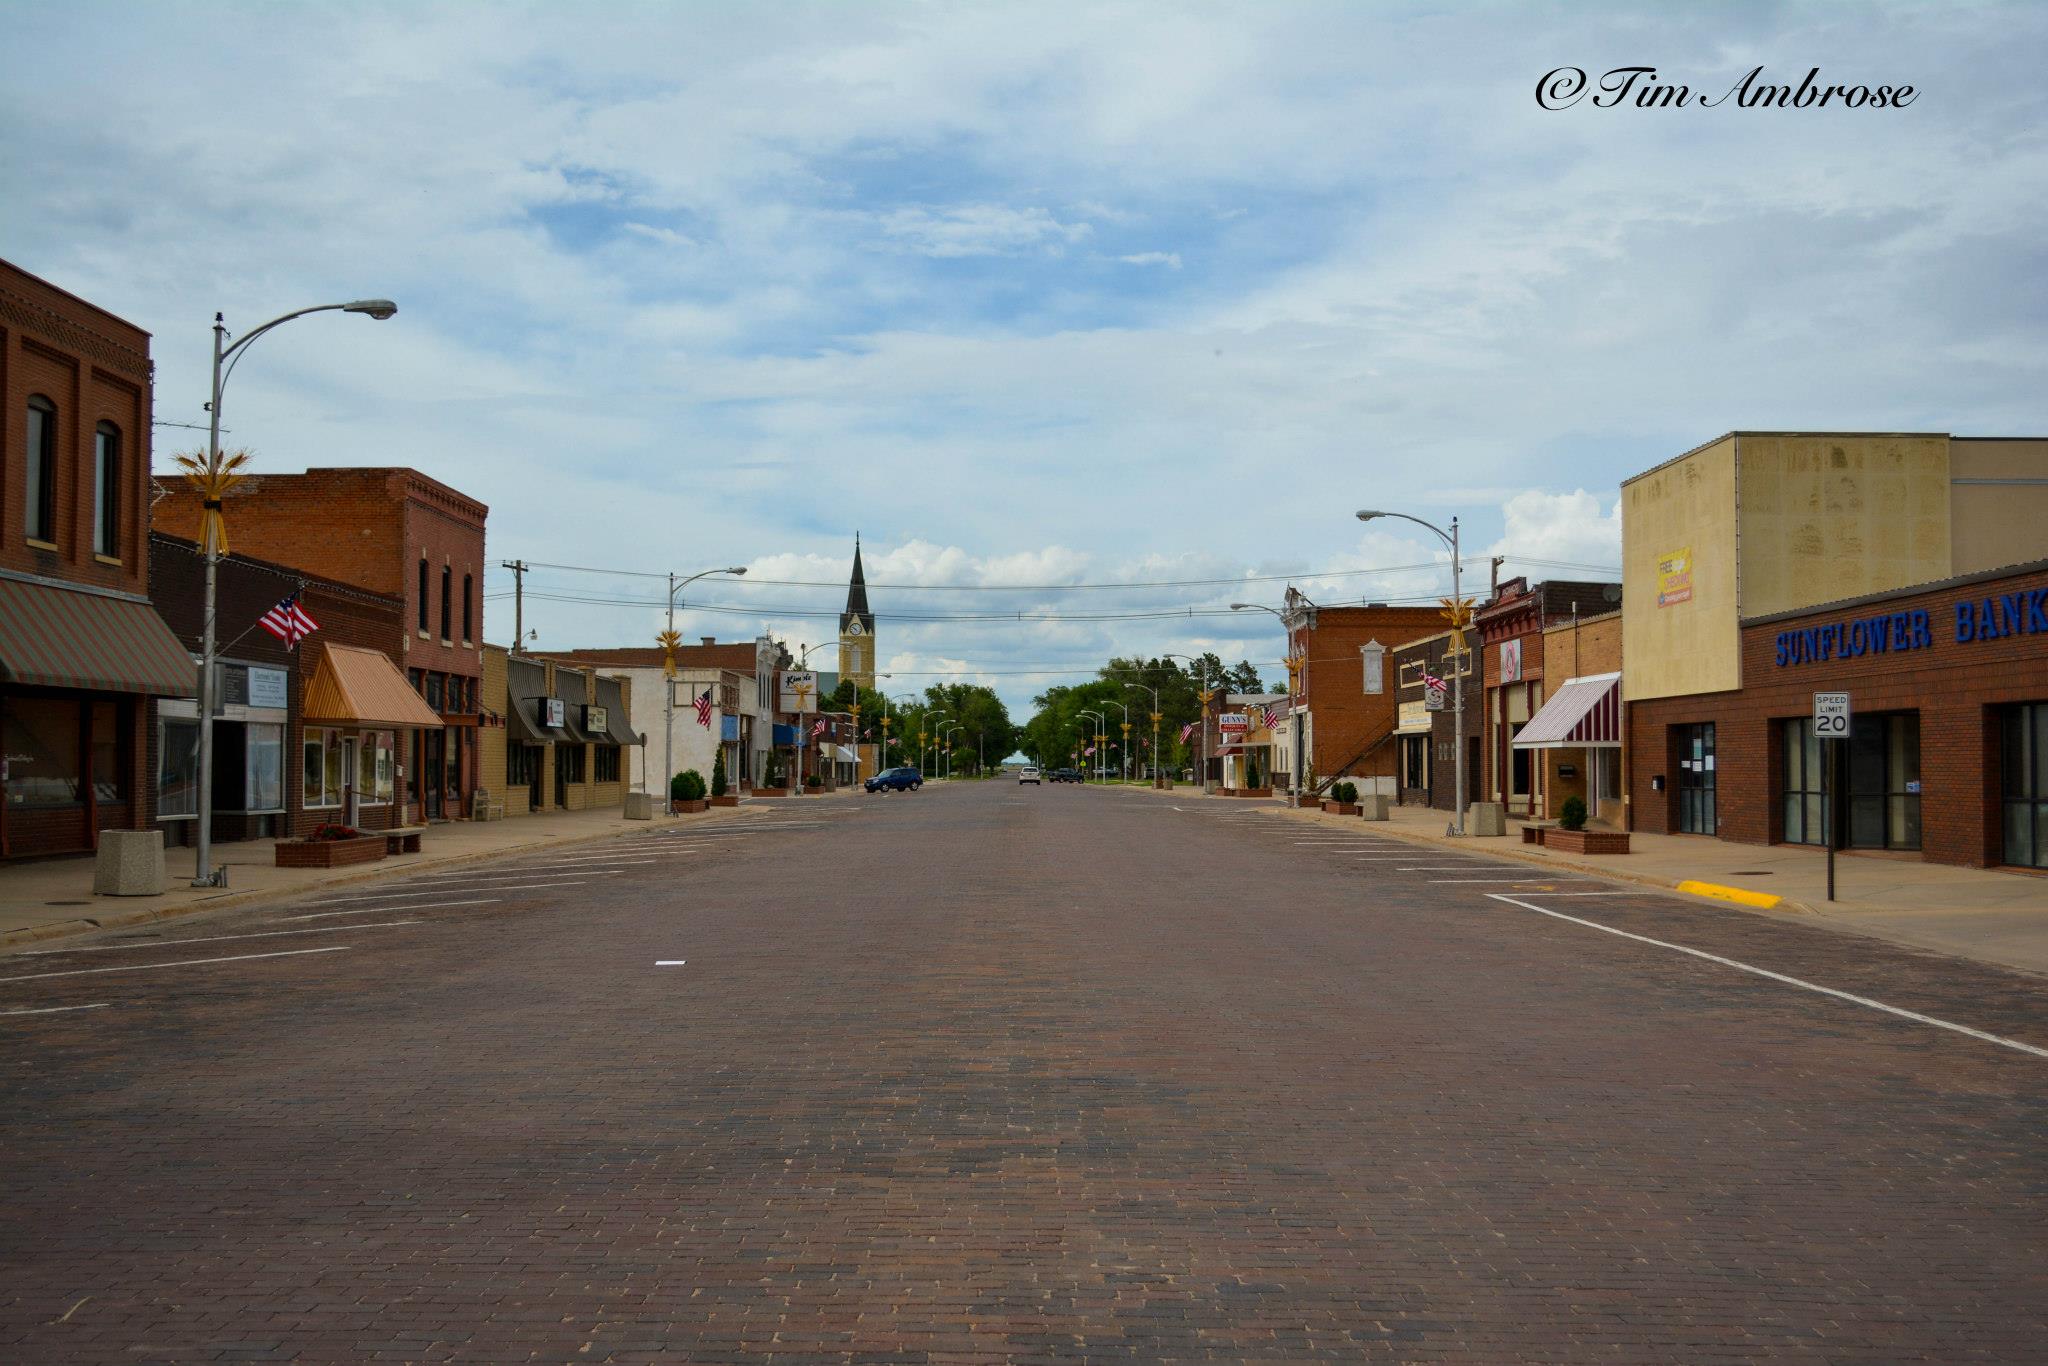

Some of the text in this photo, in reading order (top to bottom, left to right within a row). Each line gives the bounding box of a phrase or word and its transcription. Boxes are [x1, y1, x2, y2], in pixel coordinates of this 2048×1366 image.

[1775, 588, 2048, 667] SUNFLOWER BANK
[1816, 696, 1846, 704] SPEED
[1221, 715, 1246, 723] GUNN'S
[1817, 716, 1846, 731] 20
